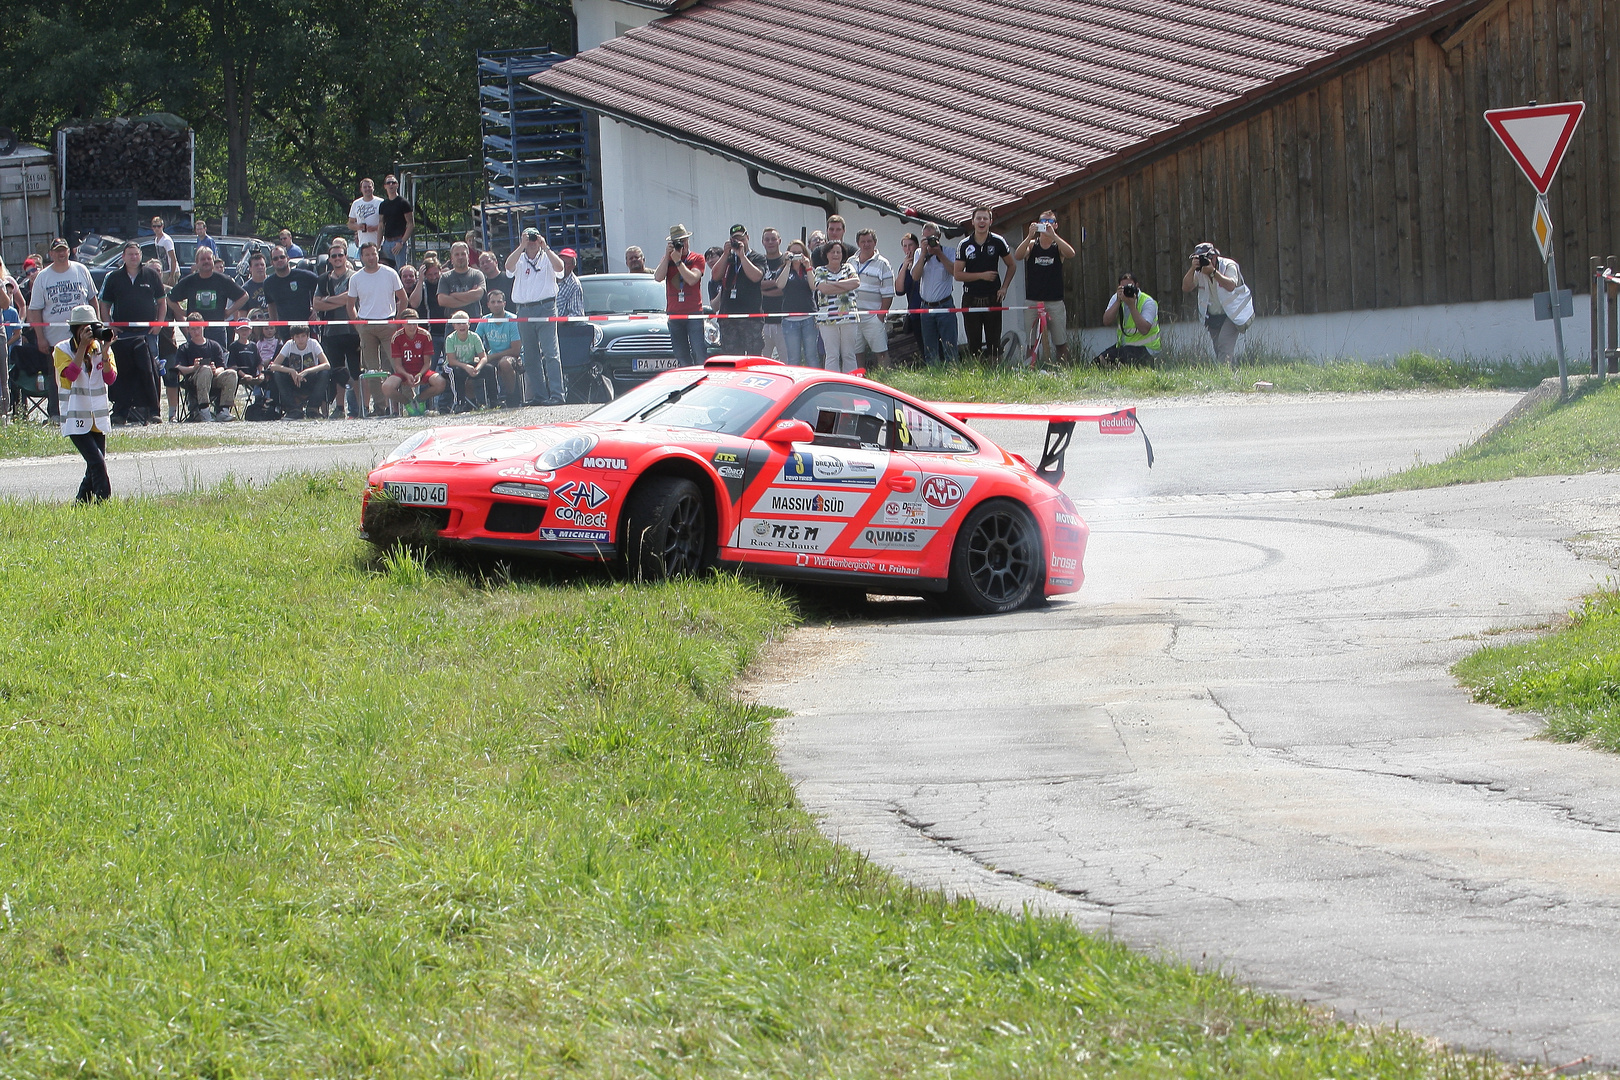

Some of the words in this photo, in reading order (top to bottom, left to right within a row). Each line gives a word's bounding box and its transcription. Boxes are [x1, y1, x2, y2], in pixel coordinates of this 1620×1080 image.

[638, 360, 649, 368] PA
[76, 420, 84, 428] 32
[894, 408, 910, 444] 3
[1101, 416, 1134, 428] deduktiv
[582, 457, 628, 470] MOTUL
[714, 452, 737, 462] ATS
[793, 452, 804, 474] 3
[414, 486, 428, 502] DO
[430, 487, 445, 502] 40
[554, 480, 610, 510] CAD
[772, 496, 812, 511] MASSIV
[824, 496, 844, 513] SÜD
[558, 530, 607, 540] MICHELIN
[772, 524, 787, 539] M
[804, 526, 819, 541] M
[750, 538, 772, 547] Race
[778, 540, 819, 551] Exhaust
[814, 556, 876, 572] Württembergische
[878, 564, 887, 572] U.
[1052, 552, 1077, 570] brose
